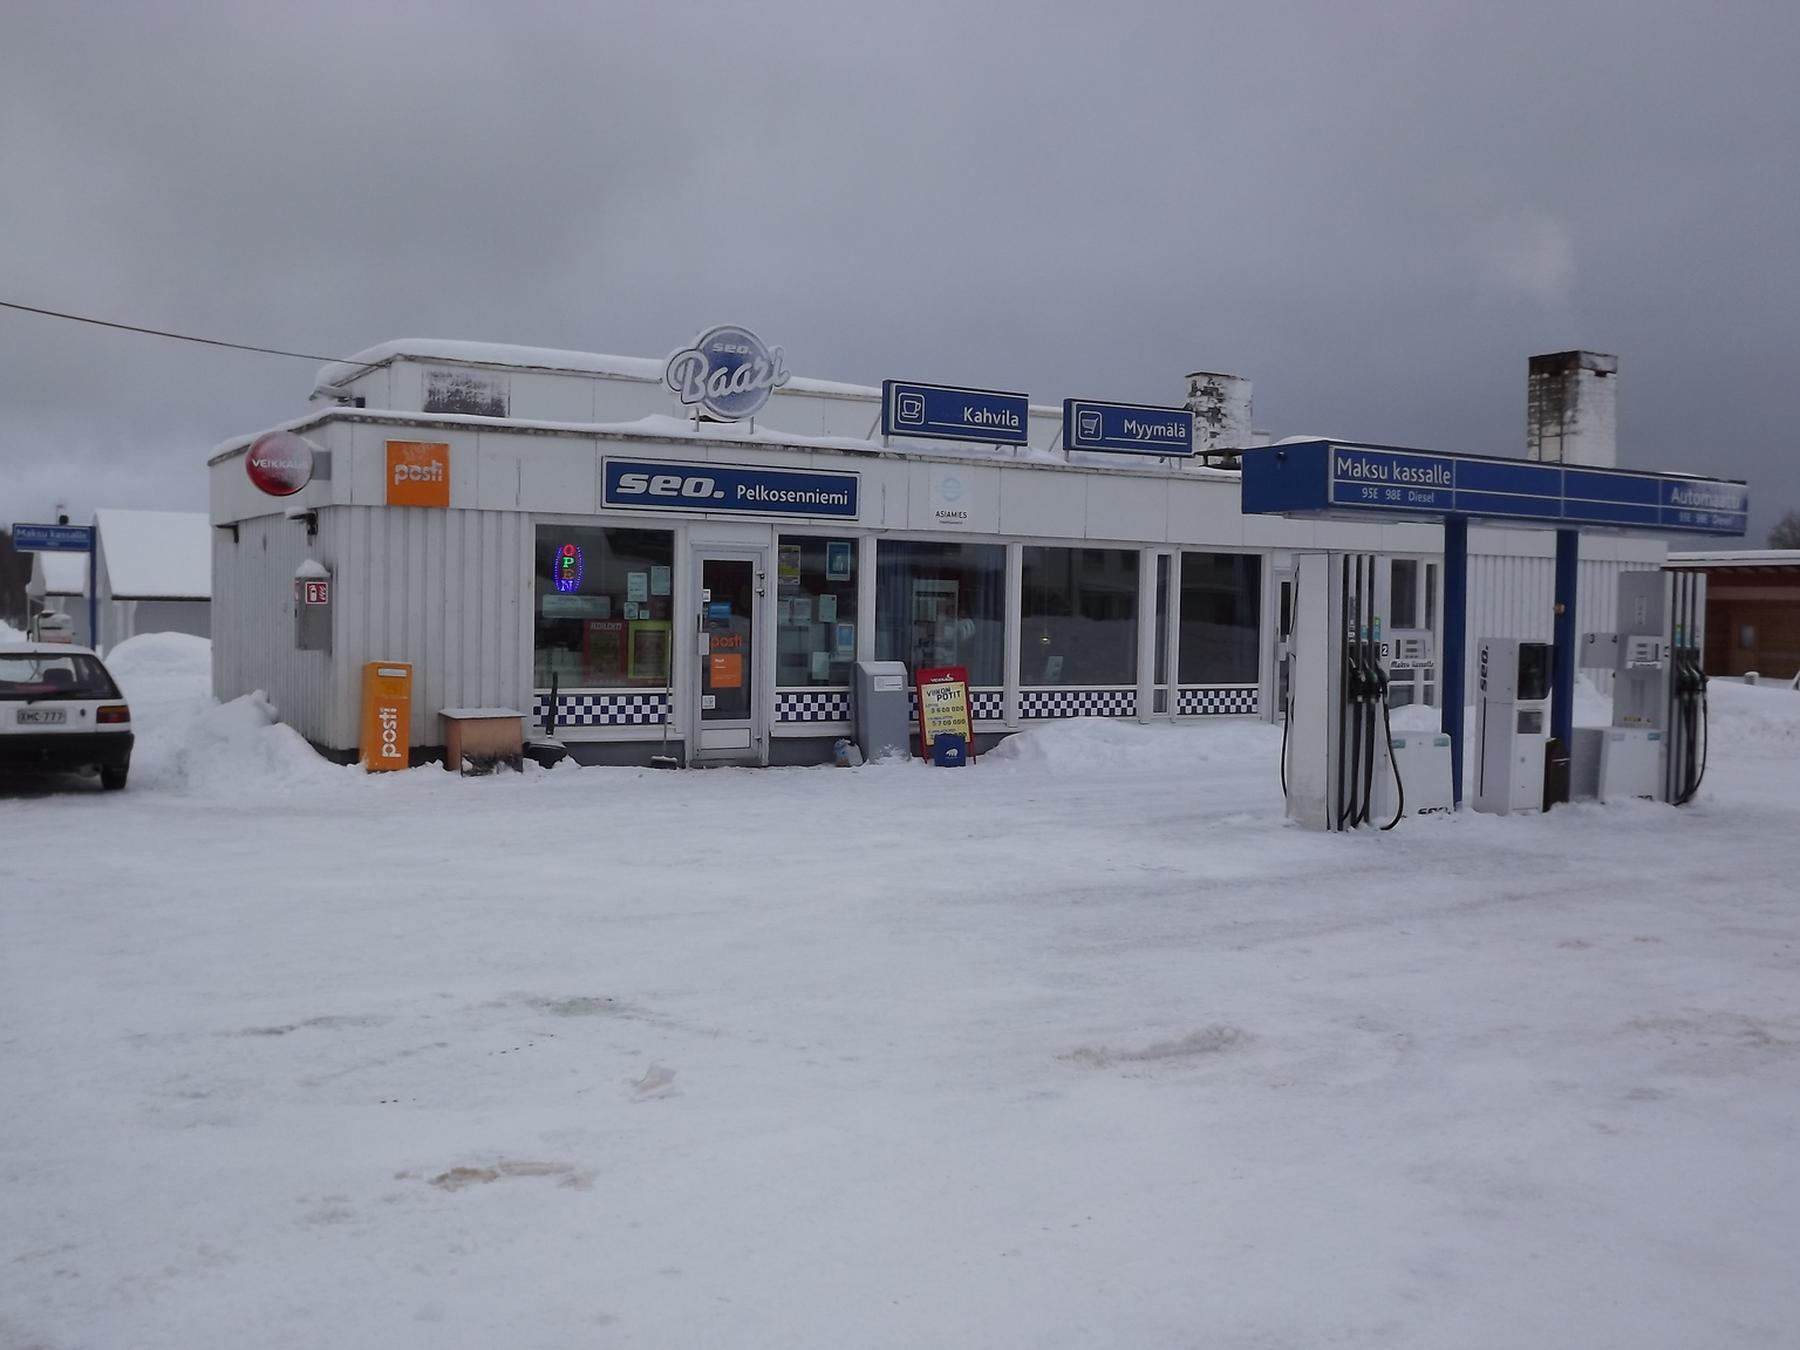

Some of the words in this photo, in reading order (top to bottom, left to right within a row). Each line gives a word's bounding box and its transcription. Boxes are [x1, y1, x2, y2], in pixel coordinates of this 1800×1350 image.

[667, 347, 791, 403] Baari
[963, 406, 1019, 427] Kahvila
[1123, 418, 1186, 440] Myymälä
[395, 460, 443, 486] posti
[1337, 457, 1388, 480] Maksu
[1392, 460, 1451, 485] kassalle
[616, 473, 725, 499] seo.
[737, 484, 848, 505] Pelkosenniemi
[1361, 487, 1379, 499] 95E
[1385, 488, 1401, 501] 98E
[1408, 490, 1434, 503] Diesel
[935, 510, 968, 519] ASIAMIES
[561, 543, 577, 592] OPEN
[711, 633, 743, 648] posti
[1382, 645, 1388, 655] 2
[927, 687, 951, 696] VIIKON
[937, 690, 961, 701] POTIT
[379, 706, 402, 758] posti
